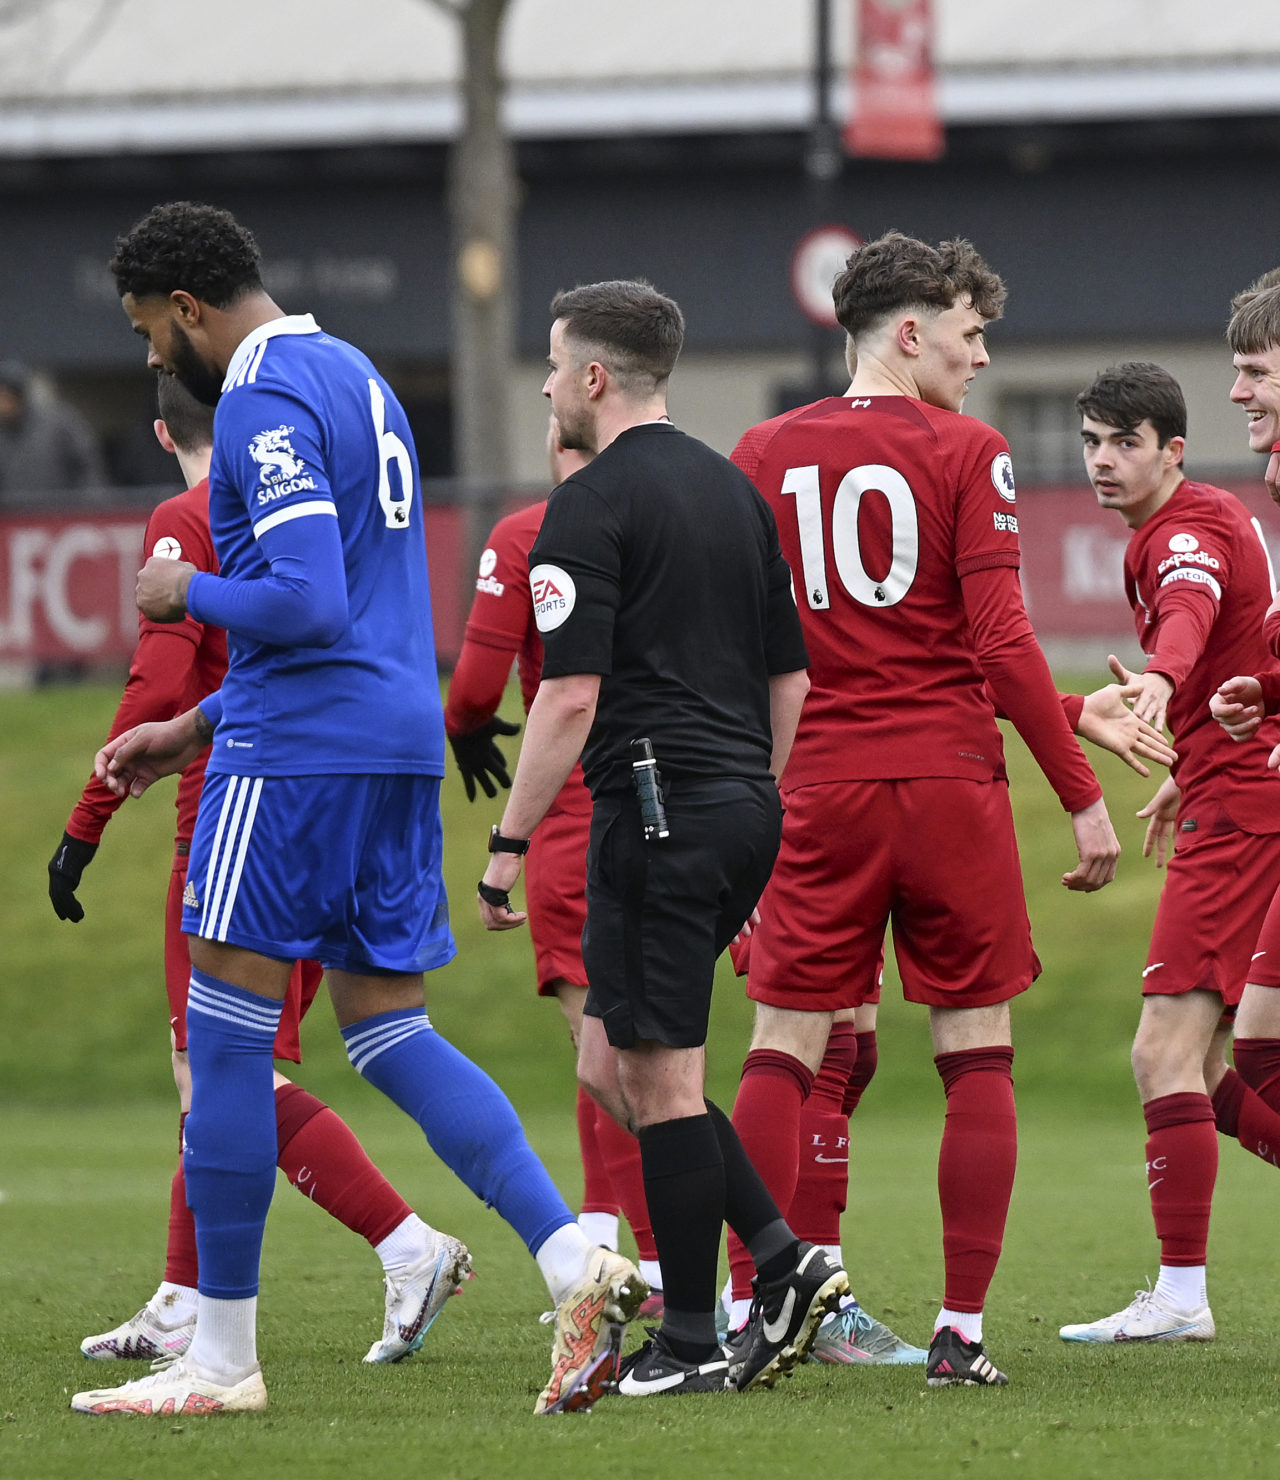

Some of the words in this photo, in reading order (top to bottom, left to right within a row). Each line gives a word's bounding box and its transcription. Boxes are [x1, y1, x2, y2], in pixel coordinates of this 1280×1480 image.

[367, 378, 414, 529] 6
[257, 476, 318, 506] SAIGON
[780, 463, 919, 610] 10
[1157, 550, 1220, 575] Expedia
[533, 579, 563, 605] EA
